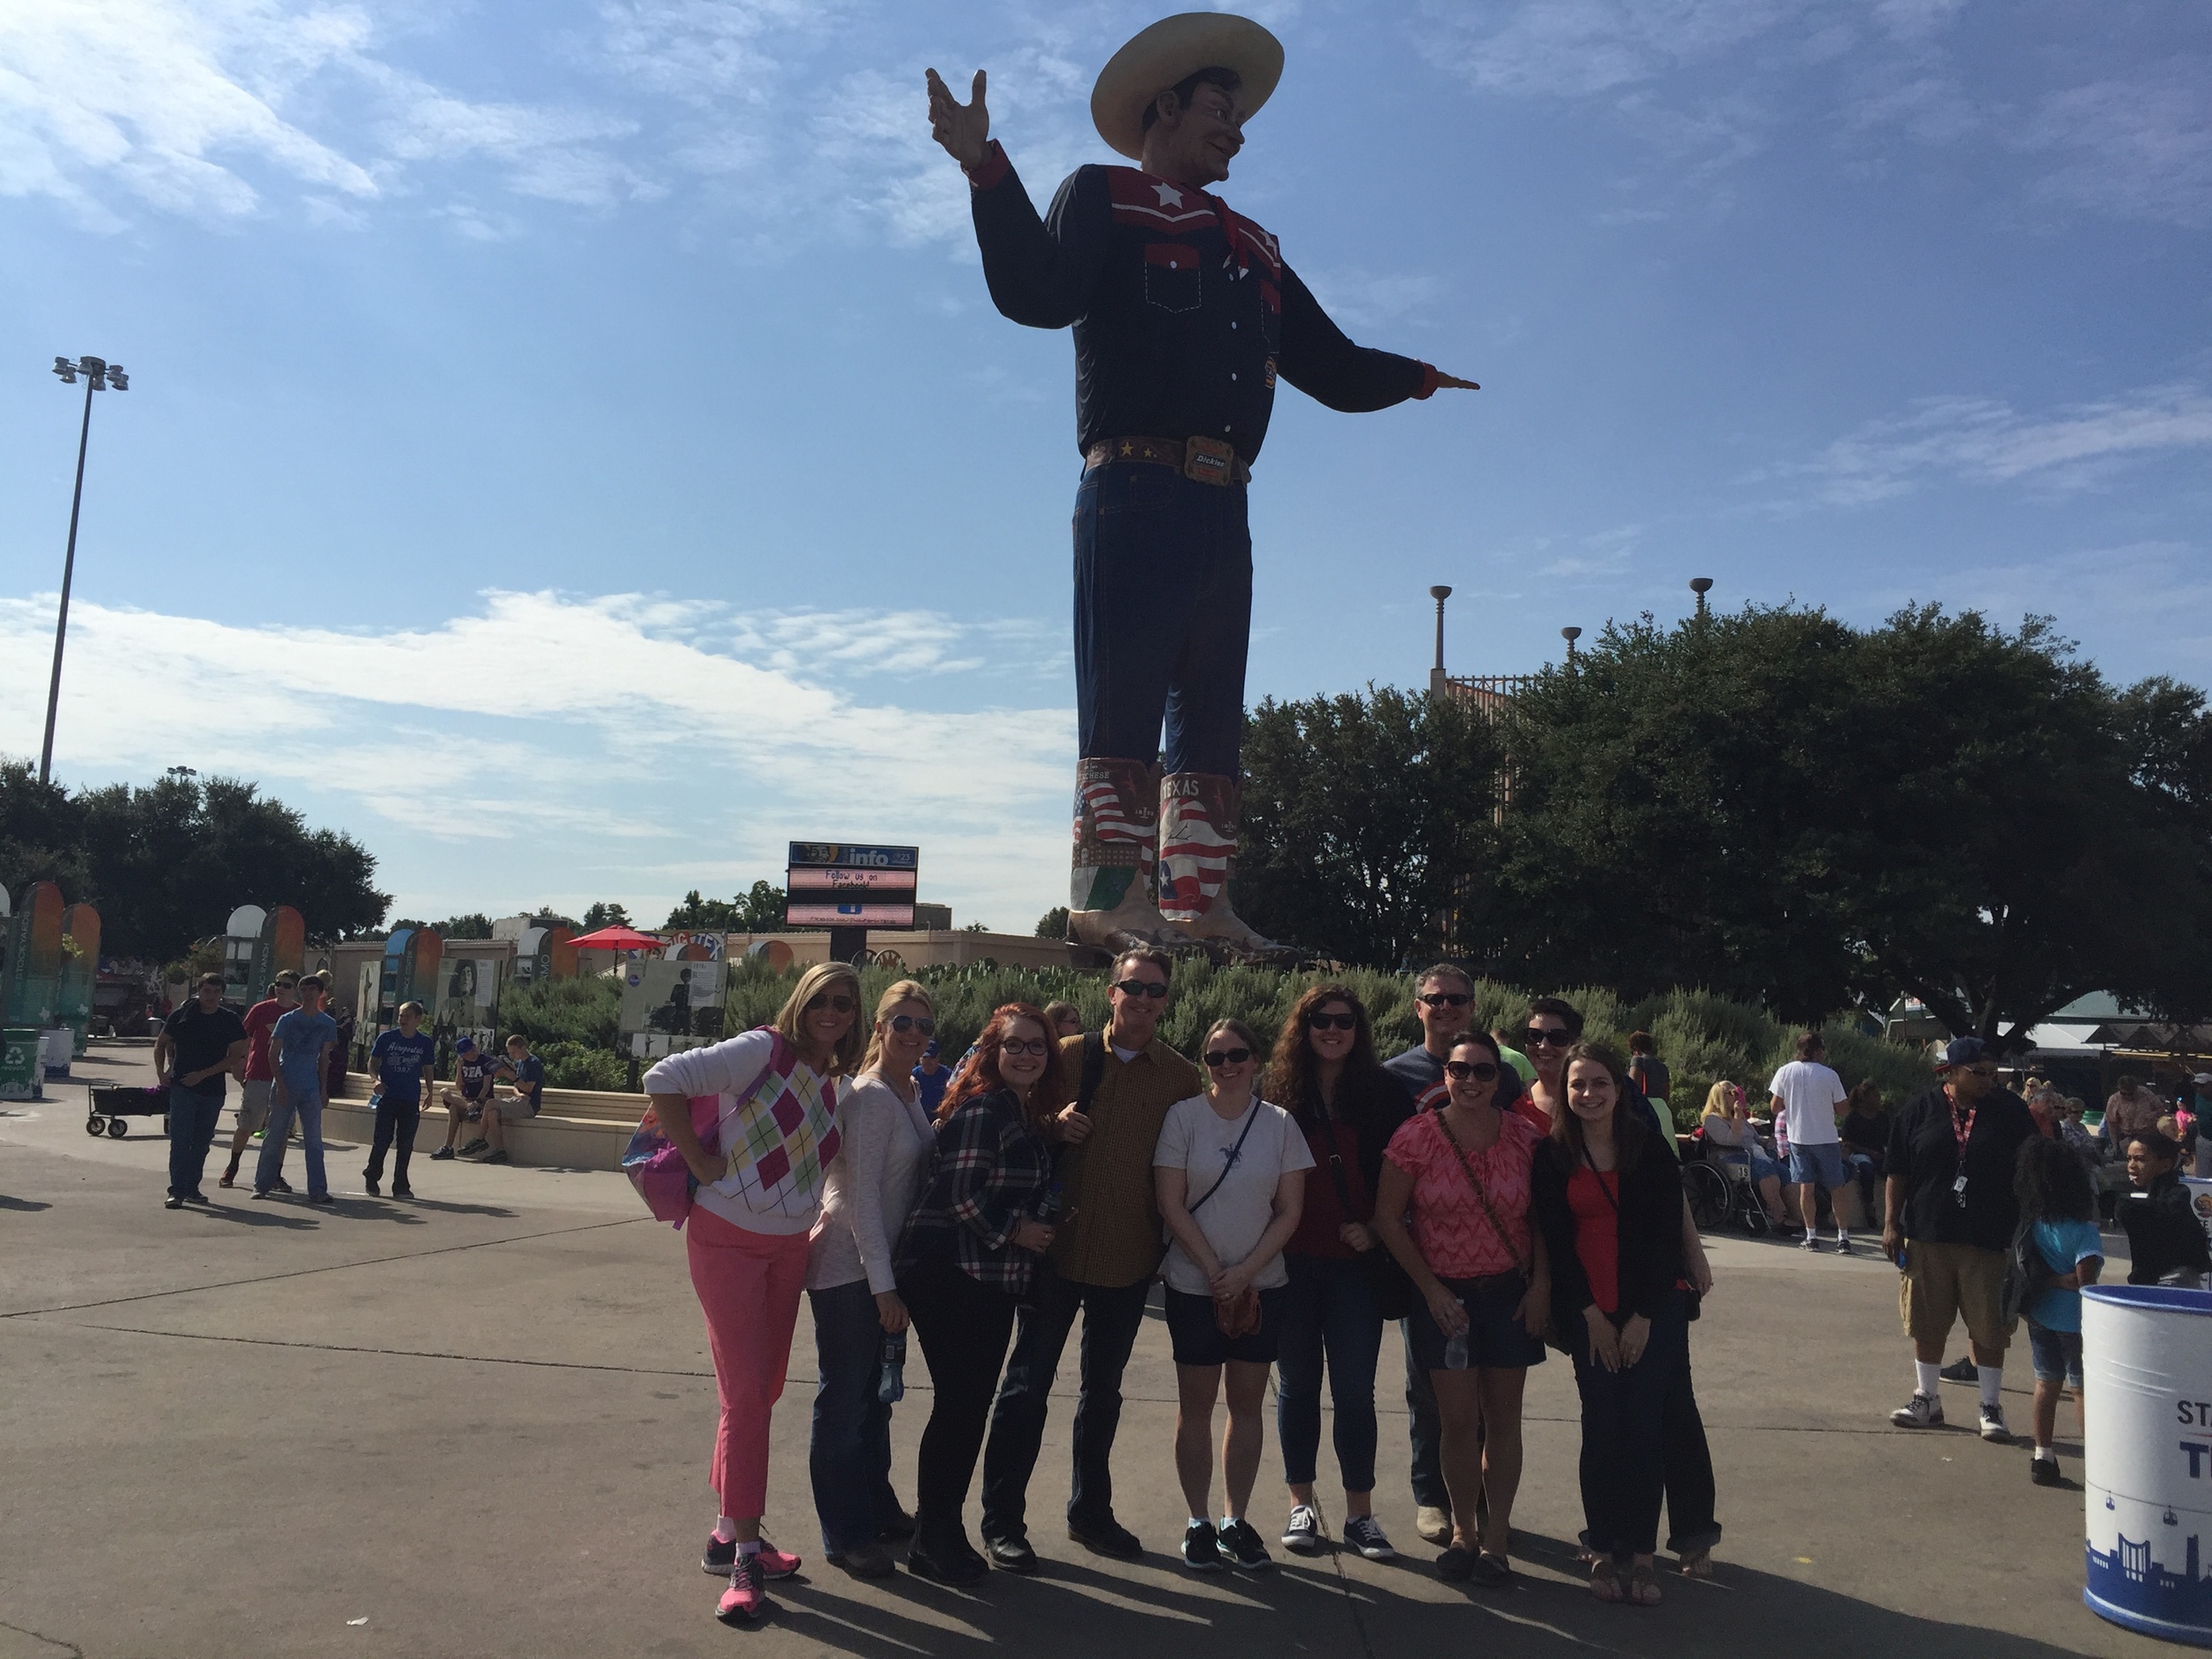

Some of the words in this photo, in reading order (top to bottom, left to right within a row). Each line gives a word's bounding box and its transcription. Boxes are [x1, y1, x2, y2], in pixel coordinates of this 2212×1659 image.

[1163, 780, 1200, 798] TEXAS
[849, 848, 888, 866] info
[826, 870, 849, 880] Follow
[15, 910, 31, 980] STOCKYARDS
[260, 942, 269, 973] RANCH
[695, 933, 721, 961] TEX
[2177, 1400, 2212, 1428] ST
[2179, 1441, 2212, 1479] T
